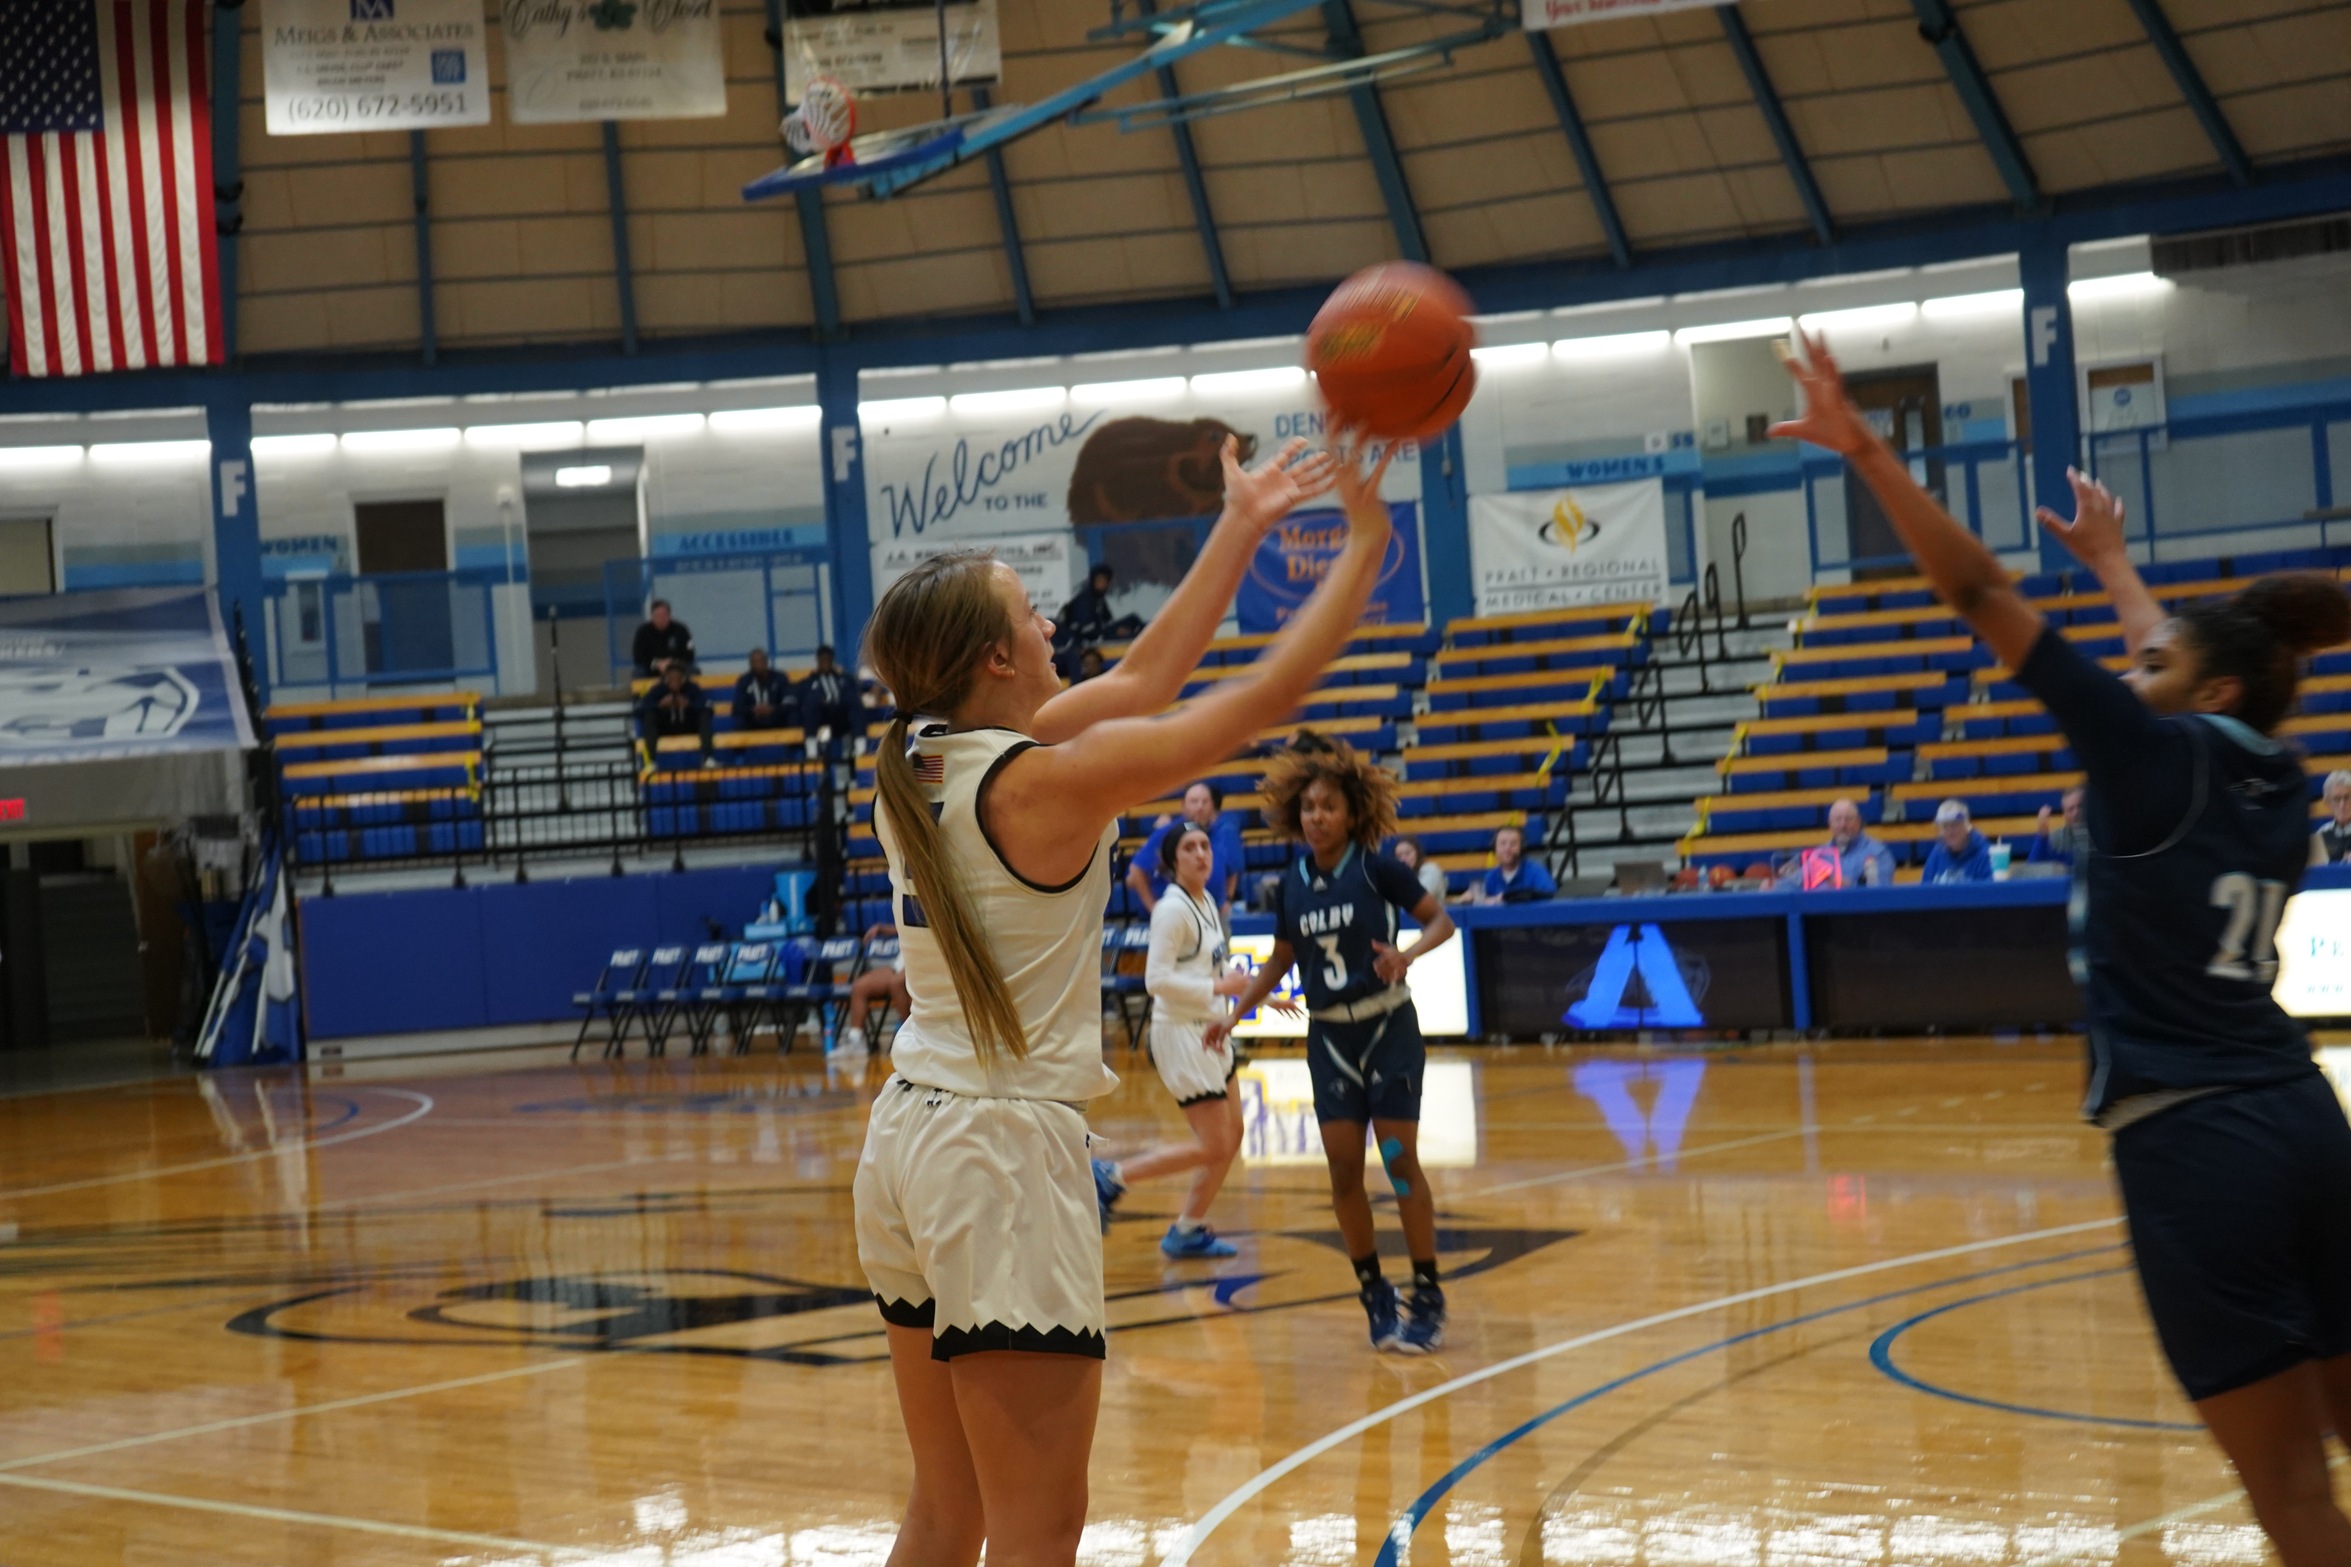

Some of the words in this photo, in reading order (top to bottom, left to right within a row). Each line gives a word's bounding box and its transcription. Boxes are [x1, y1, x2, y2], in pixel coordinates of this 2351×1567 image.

[342, 24, 358, 42] &
[288, 96, 350, 123] (620)
[356, 91, 466, 117] 672-5951
[2030, 306, 2057, 367] F
[830, 425, 858, 482] F
[219, 460, 247, 518] F
[880, 407, 1108, 540] Welcome
[984, 496, 1008, 512] TO
[1015, 492, 1048, 508] THE
[1279, 525, 1349, 551] Morg
[1561, 558, 1658, 579] REGIONAL
[1299, 903, 1354, 938] COLBY
[1316, 933, 1348, 991] 3
